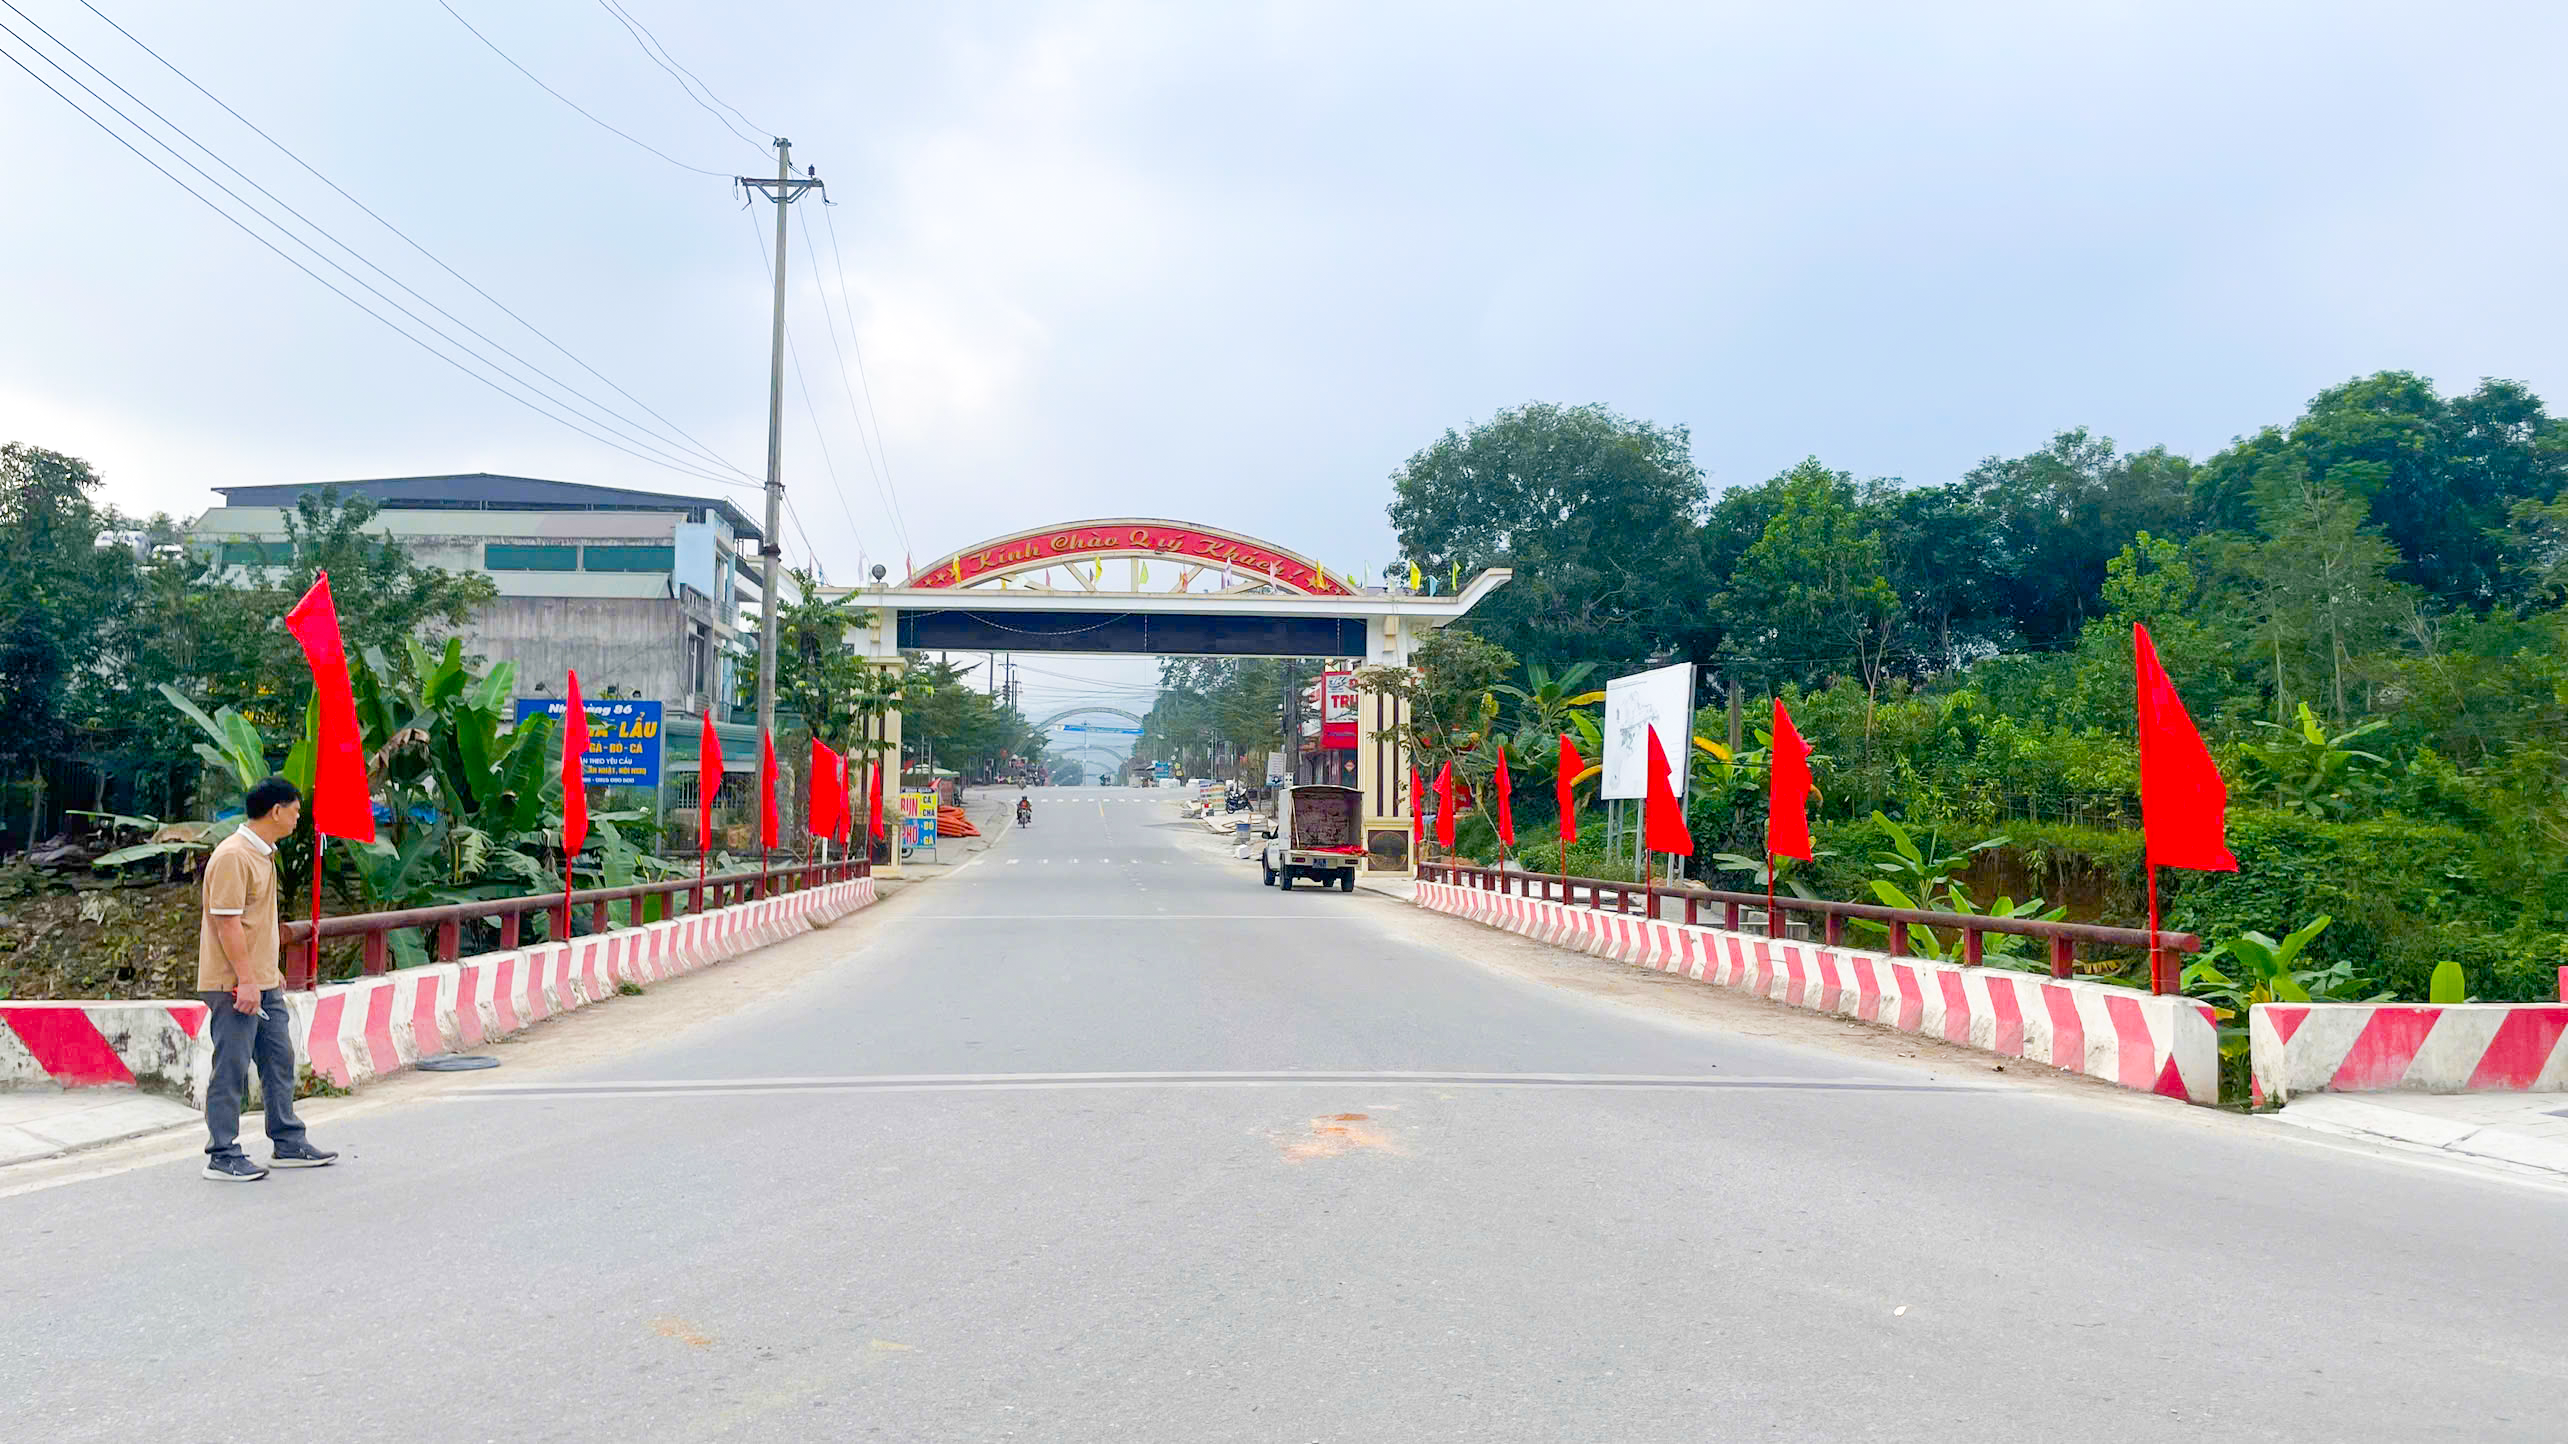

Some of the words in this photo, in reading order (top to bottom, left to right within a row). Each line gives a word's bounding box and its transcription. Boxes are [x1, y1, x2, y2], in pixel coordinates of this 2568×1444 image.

[969, 543, 1041, 573] Kính
[1050, 531, 1120, 552] Chào
[1129, 529, 1185, 552] Quý
[1192, 539, 1285, 576] Khách
[613, 704, 633, 715] 86
[618, 712, 658, 738] LẨU
[606, 756, 618, 765] YÊU
